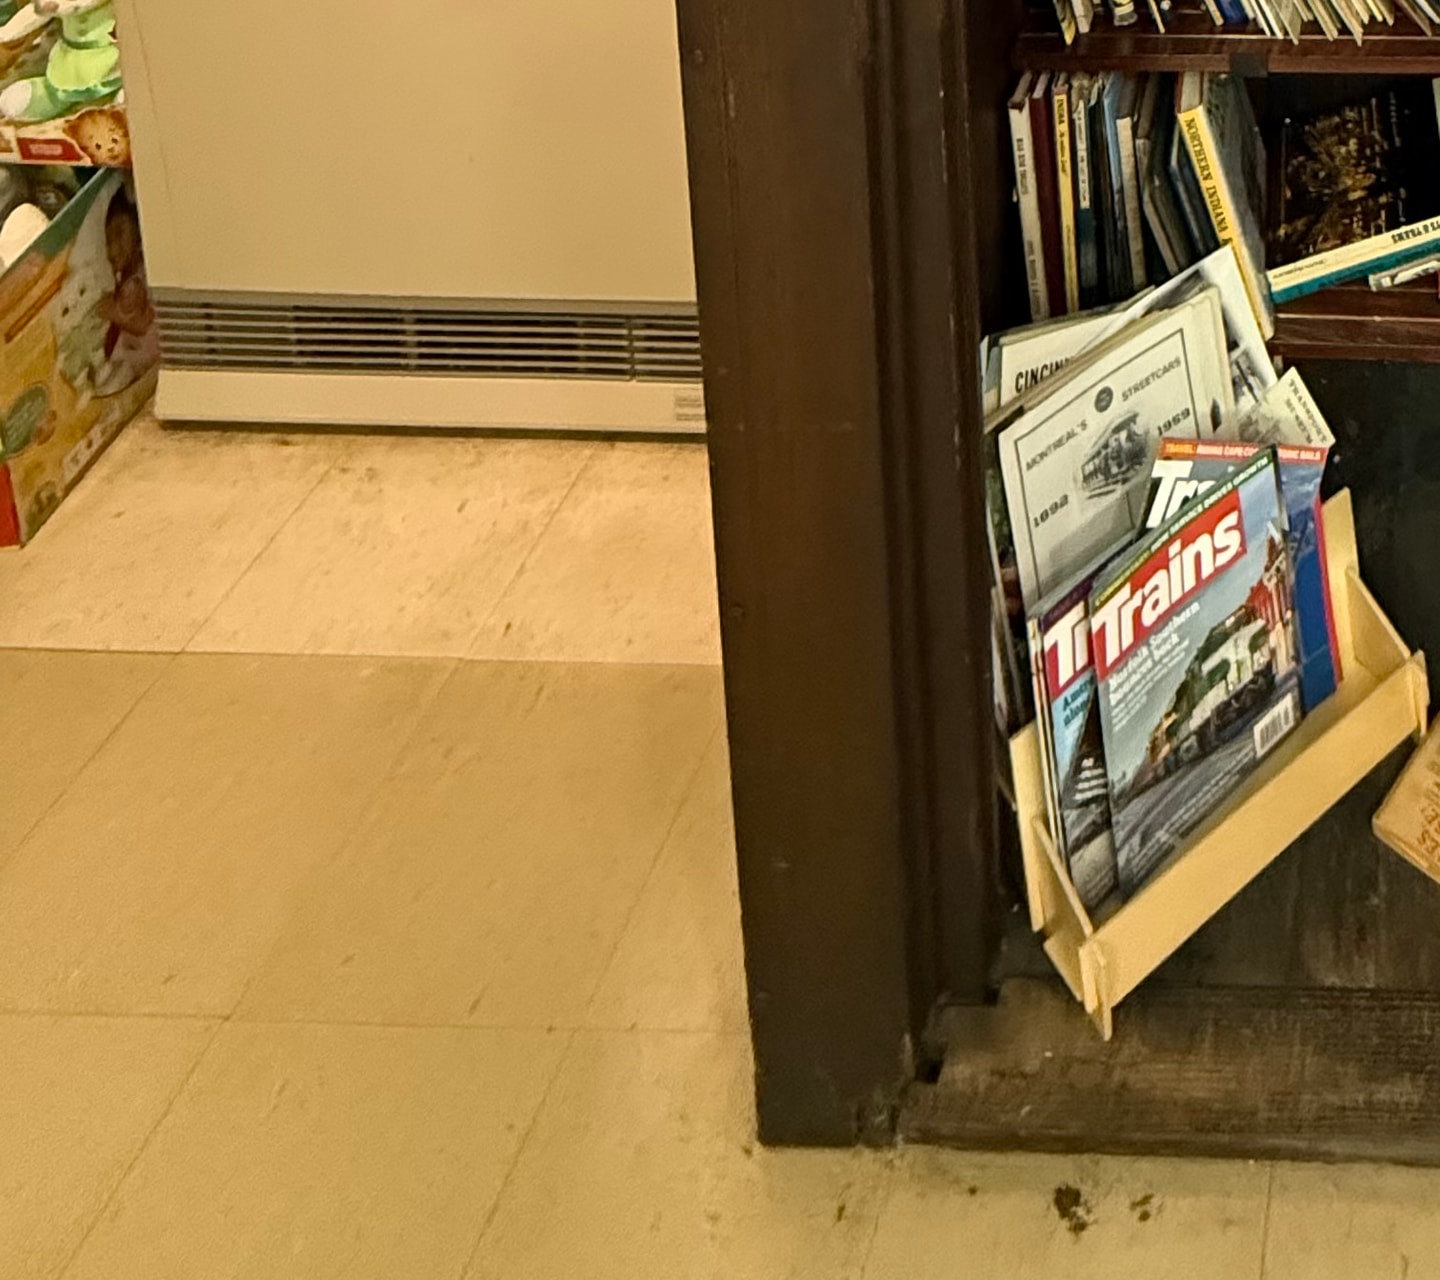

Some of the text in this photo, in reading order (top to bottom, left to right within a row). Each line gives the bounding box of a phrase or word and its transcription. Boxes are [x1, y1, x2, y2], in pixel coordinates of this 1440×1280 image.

[1185, 118, 1229, 233] NORTHERN INDIANA
[1026, 356, 1182, 472] MONTREAL'S STREETCARS
[1156, 406, 1191, 437] 1959
[1032, 494, 1070, 529] 1892
[1091, 507, 1243, 668] Trains
[1150, 602, 1200, 645] Southern
